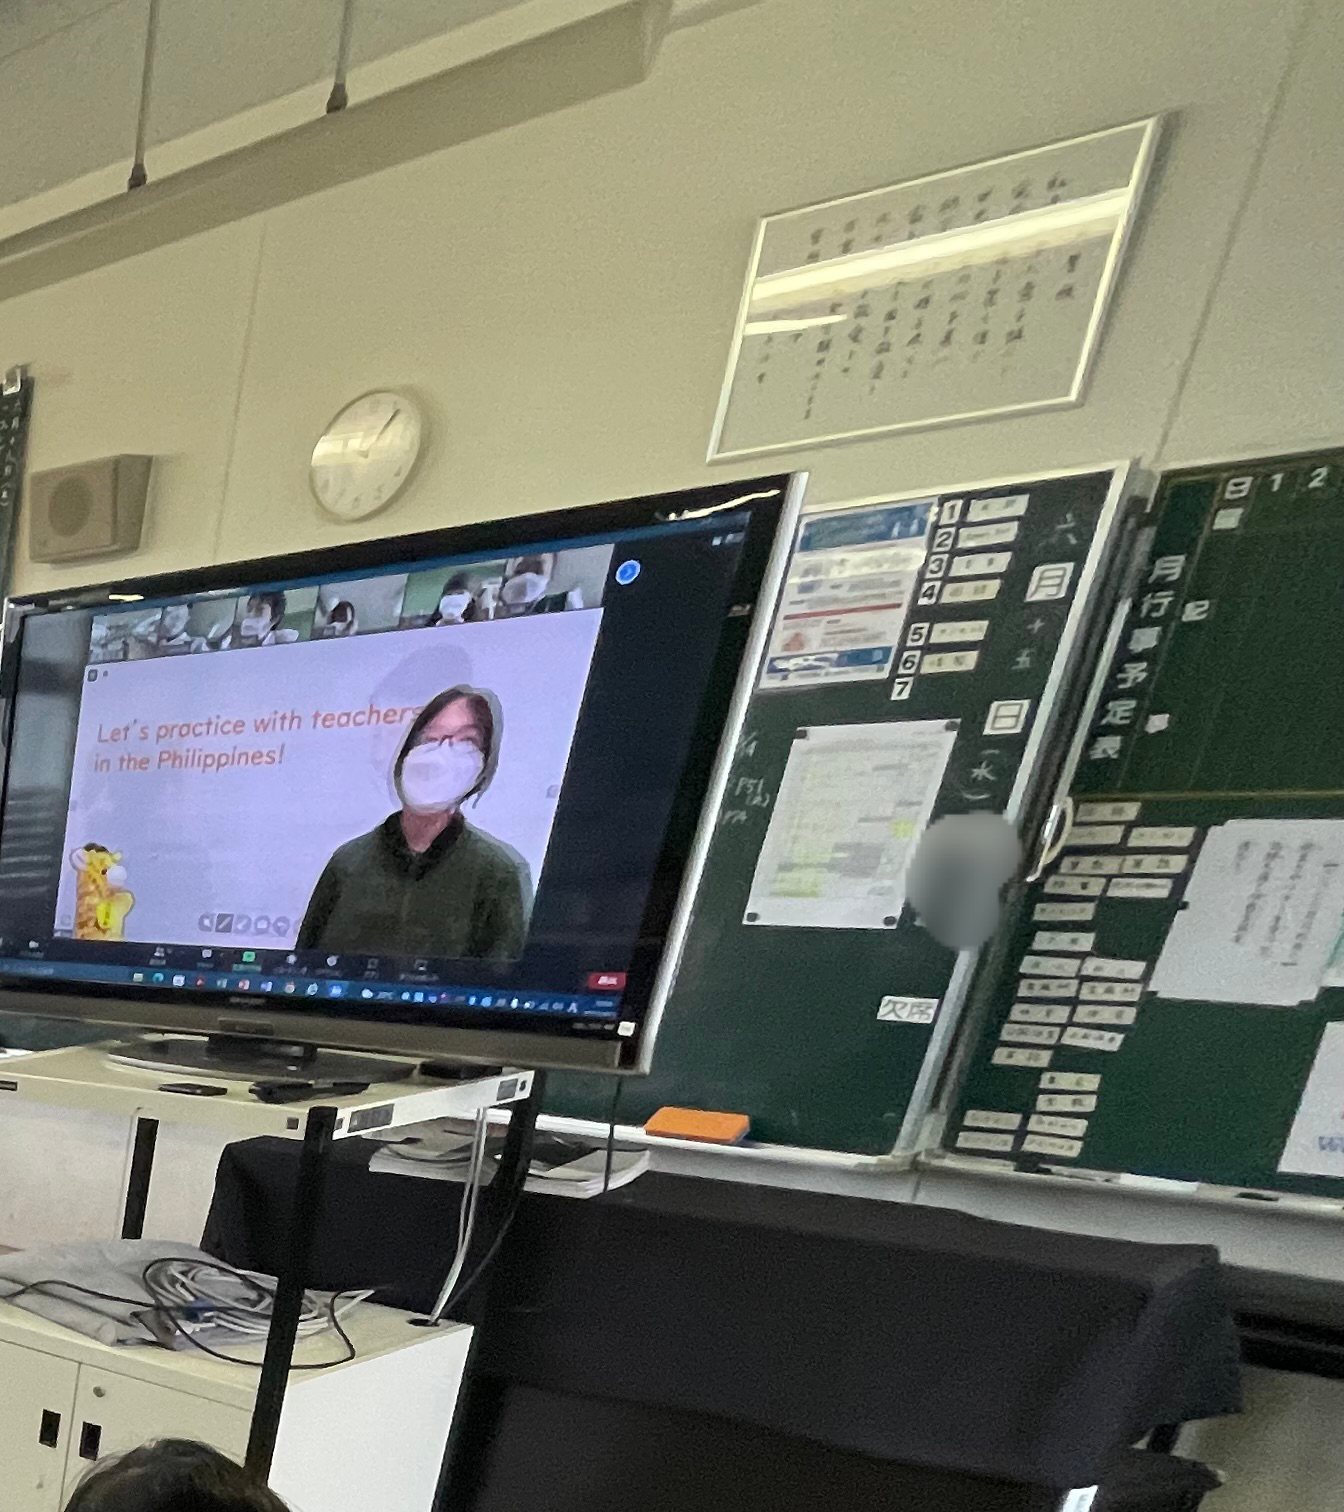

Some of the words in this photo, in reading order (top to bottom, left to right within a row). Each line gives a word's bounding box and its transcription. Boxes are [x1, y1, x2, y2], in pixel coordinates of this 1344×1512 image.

[1271, 473, 1285, 492] 1
[1308, 467, 1330, 489] 2
[938, 531, 952, 548] 2
[929, 557, 943, 574] 3
[922, 584, 936, 601] 4
[910, 626, 925, 643] 5
[902, 654, 915, 671] 6
[896, 681, 910, 697] 7
[97, 718, 150, 744] Let's
[156, 715, 246, 745] practice
[254, 709, 302, 734] with
[94, 752, 110, 773] in
[119, 752, 150, 772] the
[157, 742, 285, 774] Philippines!
[879, 999, 934, 1021] 欠席
